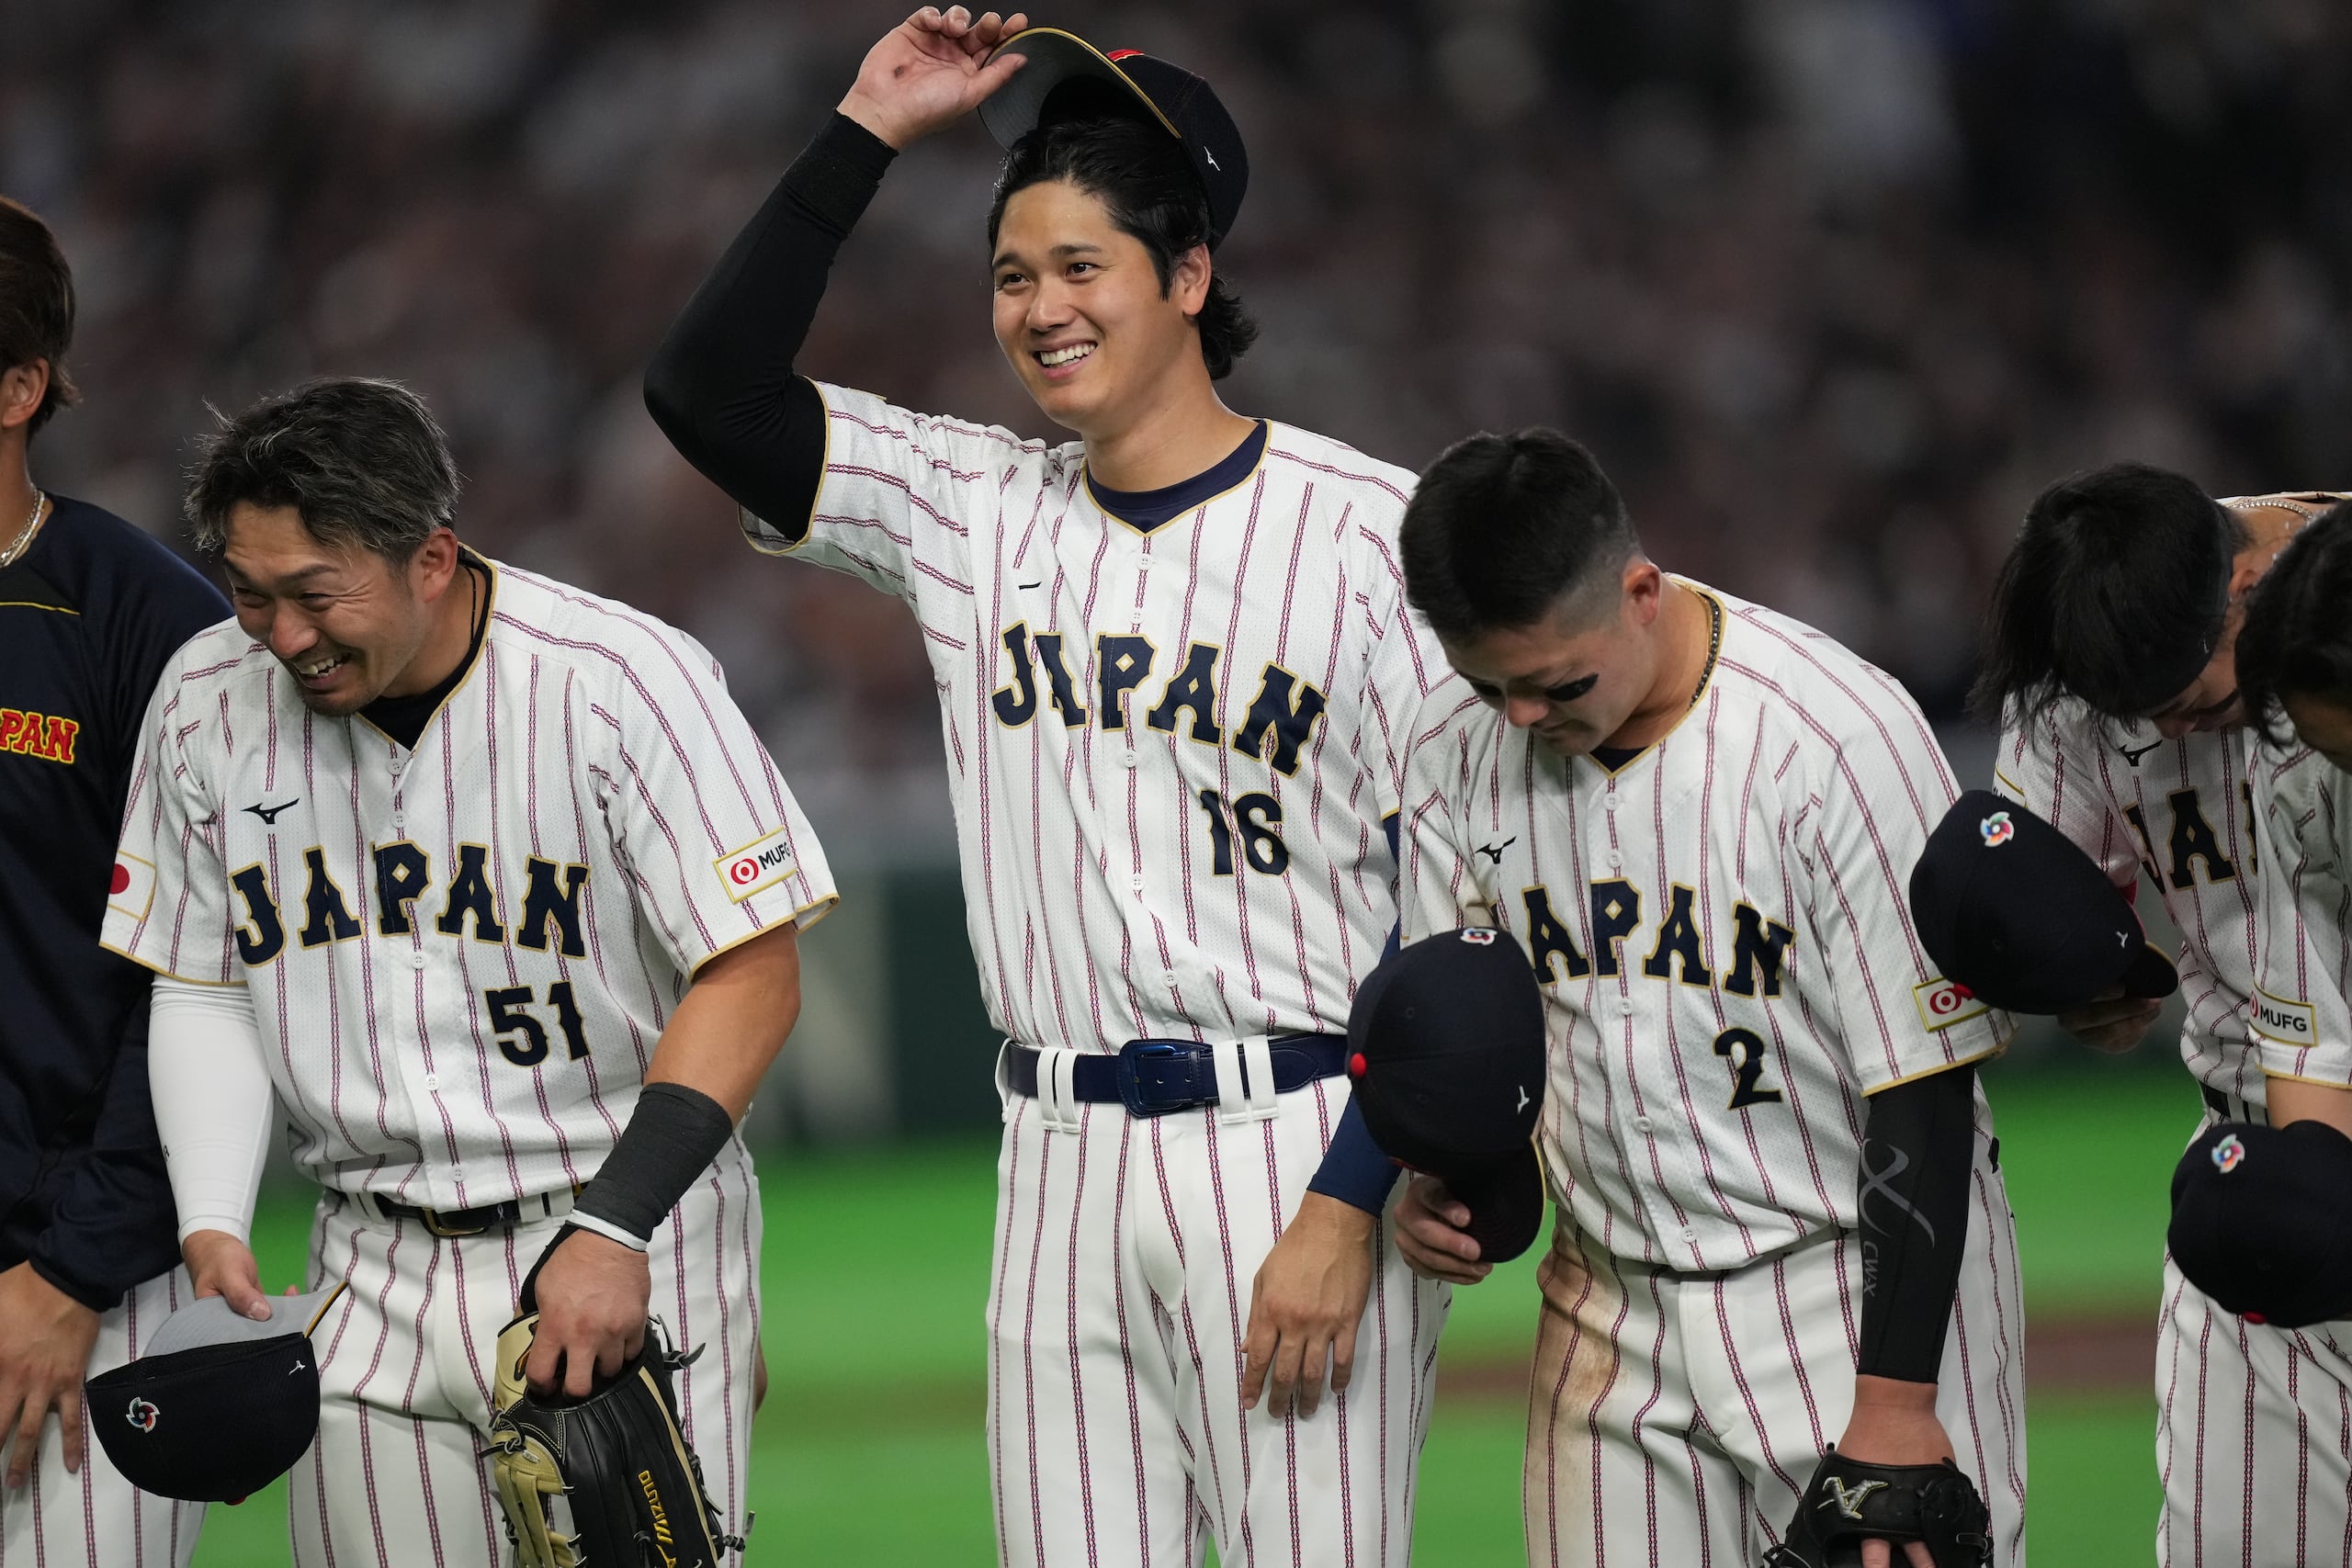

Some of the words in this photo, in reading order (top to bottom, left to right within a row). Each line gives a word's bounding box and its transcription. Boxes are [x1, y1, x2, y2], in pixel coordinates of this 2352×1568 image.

[990, 619, 1329, 779] JAPAN
[1198, 788, 1290, 876] 16
[228, 840, 591, 968] JAPAN
[1488, 876, 1797, 999] APAN
[482, 980, 593, 1067] 51
[2259, 1009, 2307, 1032] MUFG
[1713, 1027, 1784, 1111] 2
